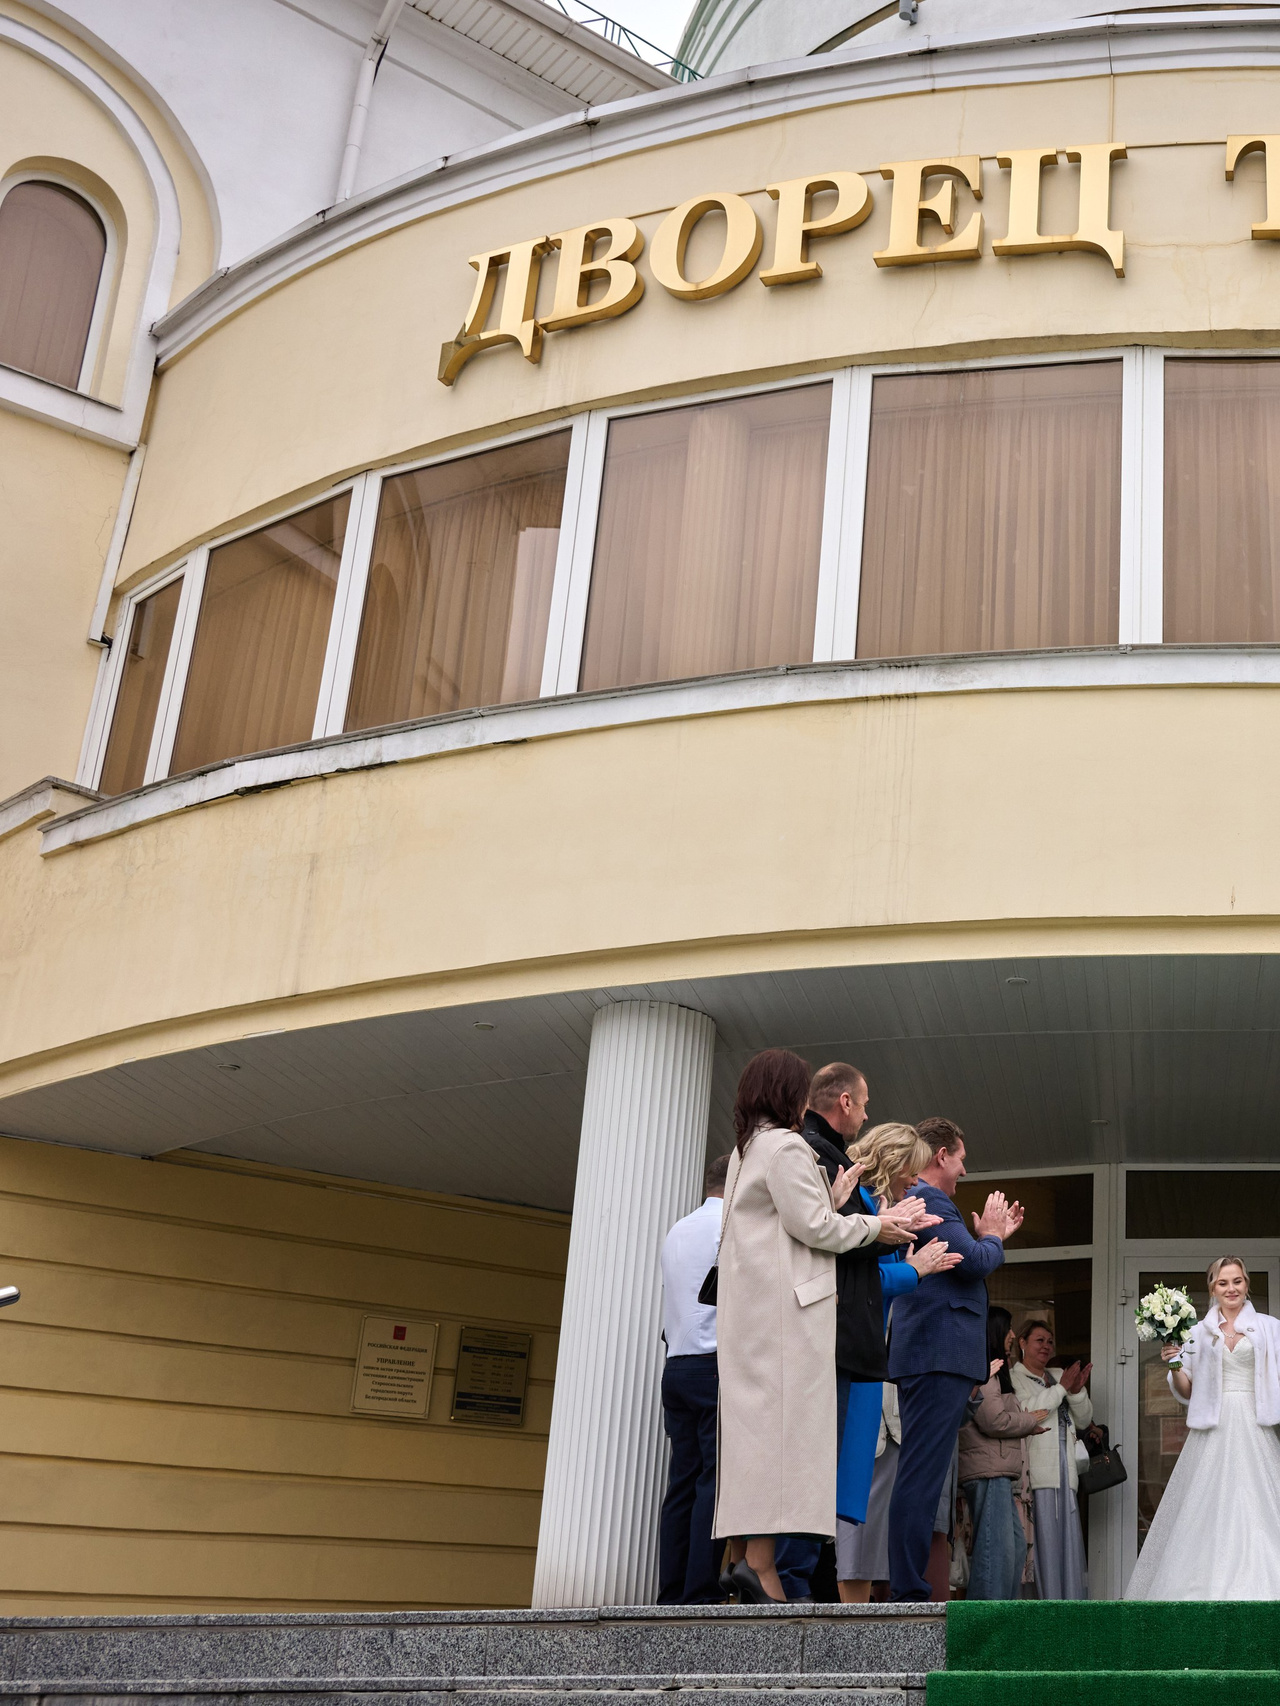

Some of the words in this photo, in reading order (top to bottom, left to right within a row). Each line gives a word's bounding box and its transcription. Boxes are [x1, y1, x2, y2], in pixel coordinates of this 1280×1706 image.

[438, 142, 1128, 387] ДВОРЕЦ
[367, 1342, 398, 1350] РОССИЙСКАЯ
[376, 1357, 415, 1367] УПРАВЛЕНИЕ
